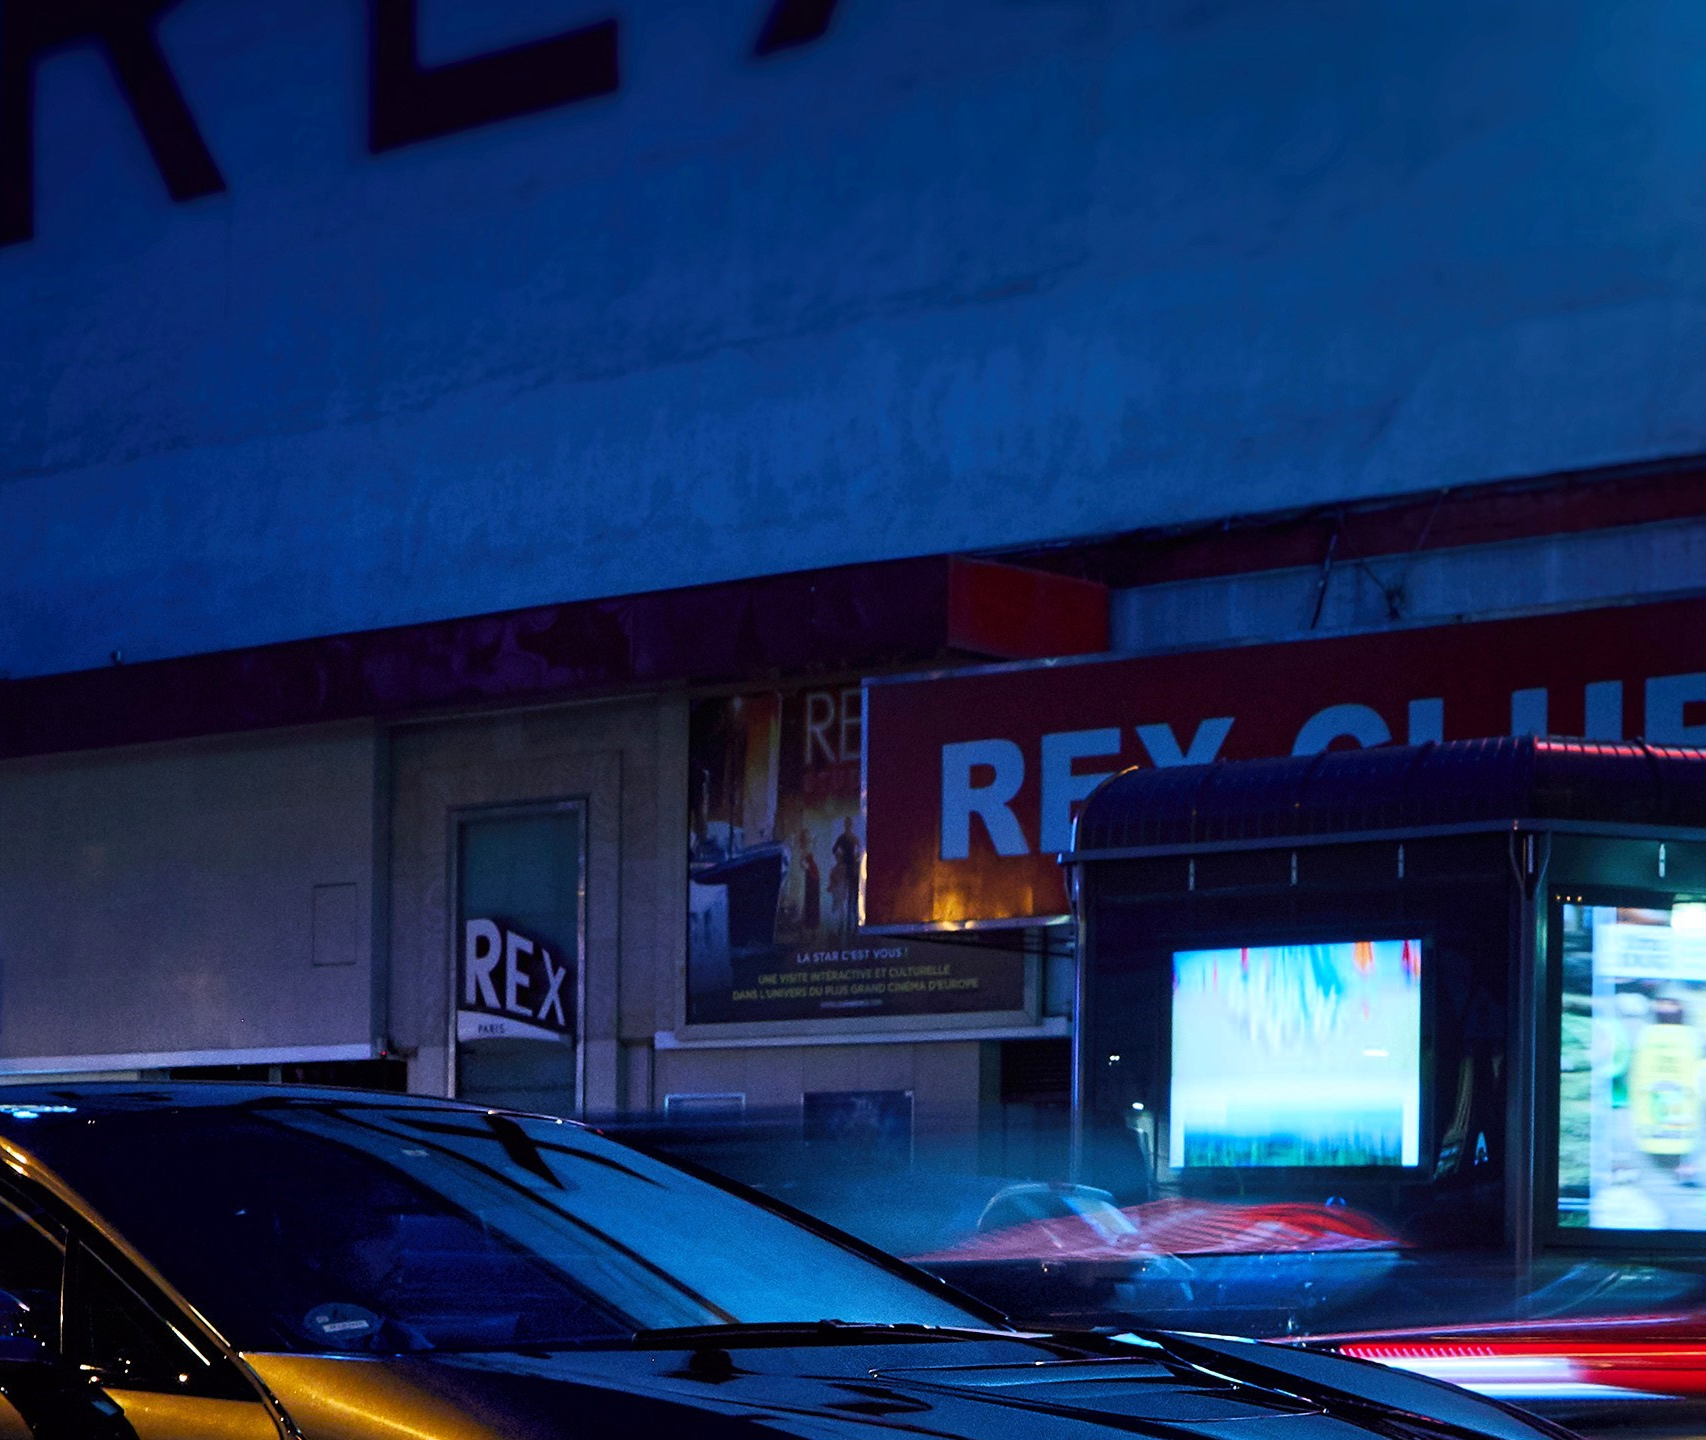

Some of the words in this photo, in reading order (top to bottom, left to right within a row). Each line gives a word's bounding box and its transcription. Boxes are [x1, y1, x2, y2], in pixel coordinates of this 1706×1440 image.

[797, 952, 810, 964] LA
[813, 951, 839, 963] STAR
[842, 949, 870, 961] C'EST
[873, 948, 902, 960] VOUS
[465, 918, 567, 1027] REX
[758, 973, 777, 985] UNE
[780, 972, 808, 984] VISITE
[875, 967, 887, 979] ET
[732, 989, 757, 1001] DANS
[809, 985, 822, 997] DU
[825, 984, 848, 997] PLUS
[850, 982, 885, 996] GRAND
